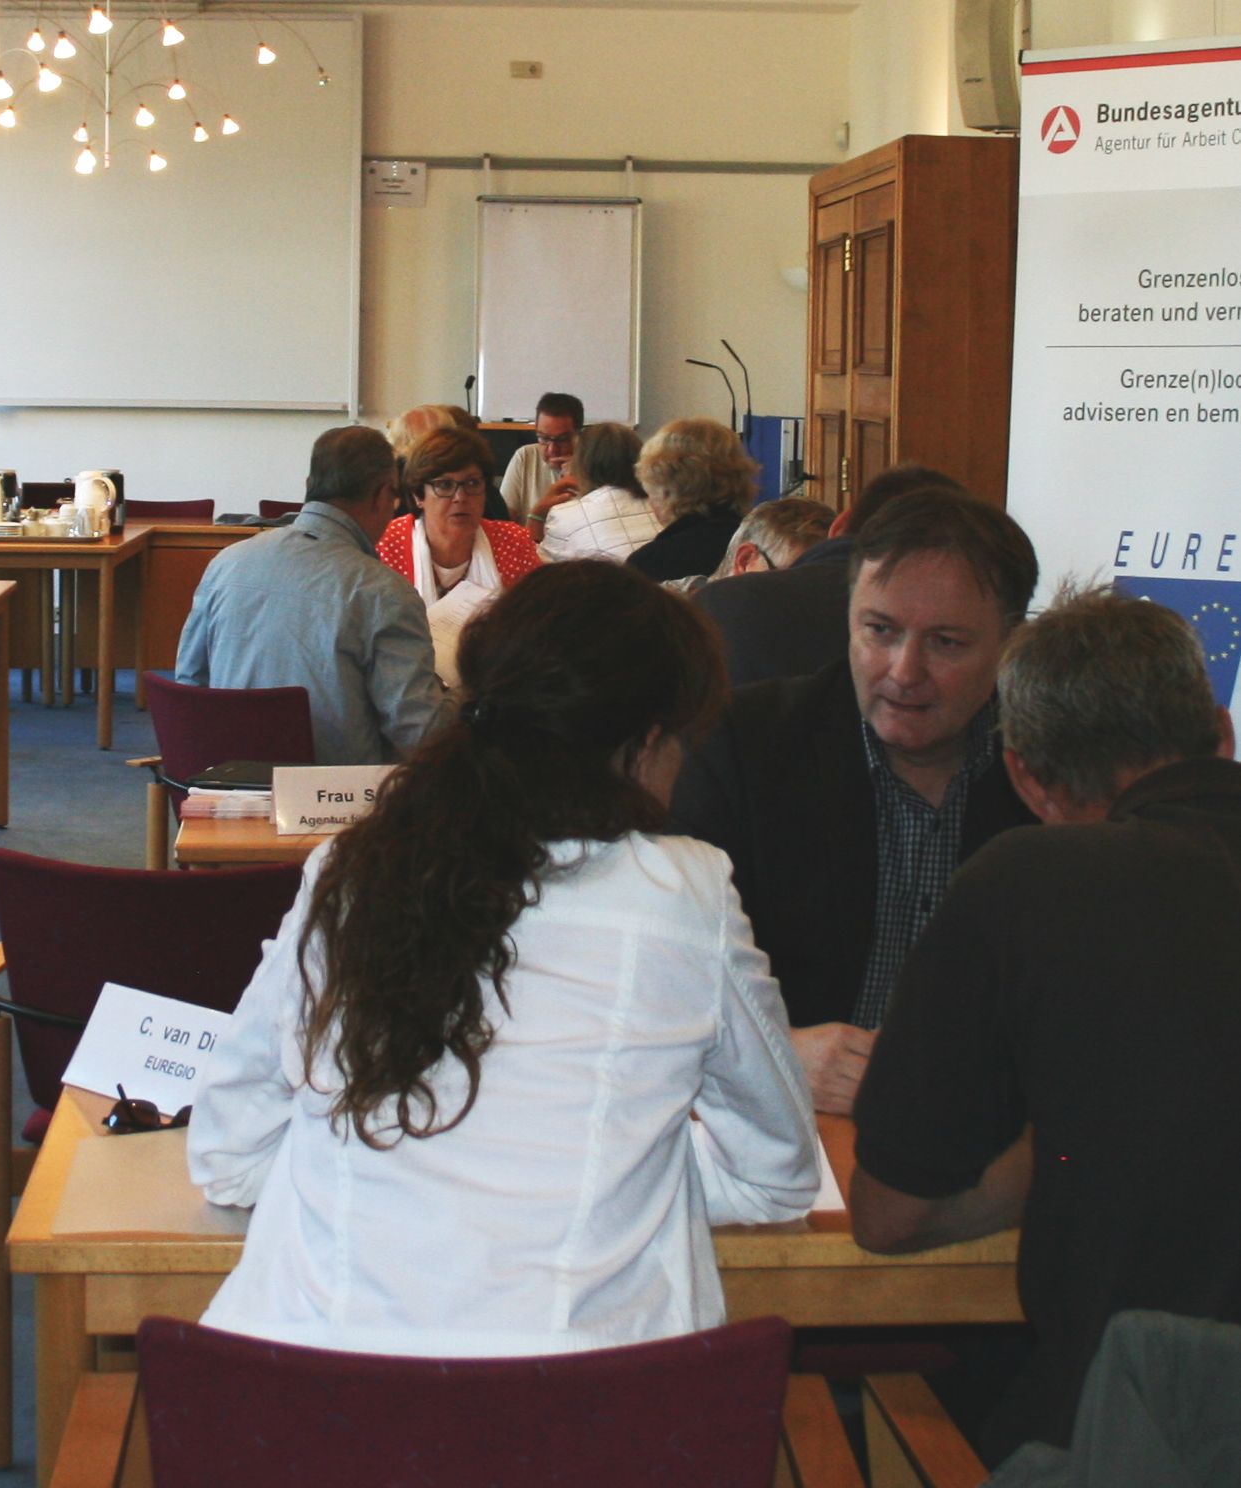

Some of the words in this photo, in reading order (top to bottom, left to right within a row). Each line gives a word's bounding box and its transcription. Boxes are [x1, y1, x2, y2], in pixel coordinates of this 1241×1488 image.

[1095, 136, 1151, 154] Agentur
[1157, 132, 1176, 148] für
[1183, 130, 1227, 147] Arbeit
[1138, 267, 1241, 288] Grenzenlo
[1078, 303, 1154, 322] beraten
[1161, 302, 1198, 321] und
[1205, 306, 1241, 321] ver
[1063, 402, 1159, 422] adviseren
[1166, 407, 1189, 422] en
[1197, 402, 1240, 423] bem
[1114, 530, 1236, 571] EURE
[317, 790, 354, 803] Frau
[299, 816, 347, 827] Agentur
[139, 1016, 153, 1036] C.
[164, 1026, 190, 1045] van
[197, 1031, 218, 1052] Di
[144, 1055, 196, 1080] EUREGIO
